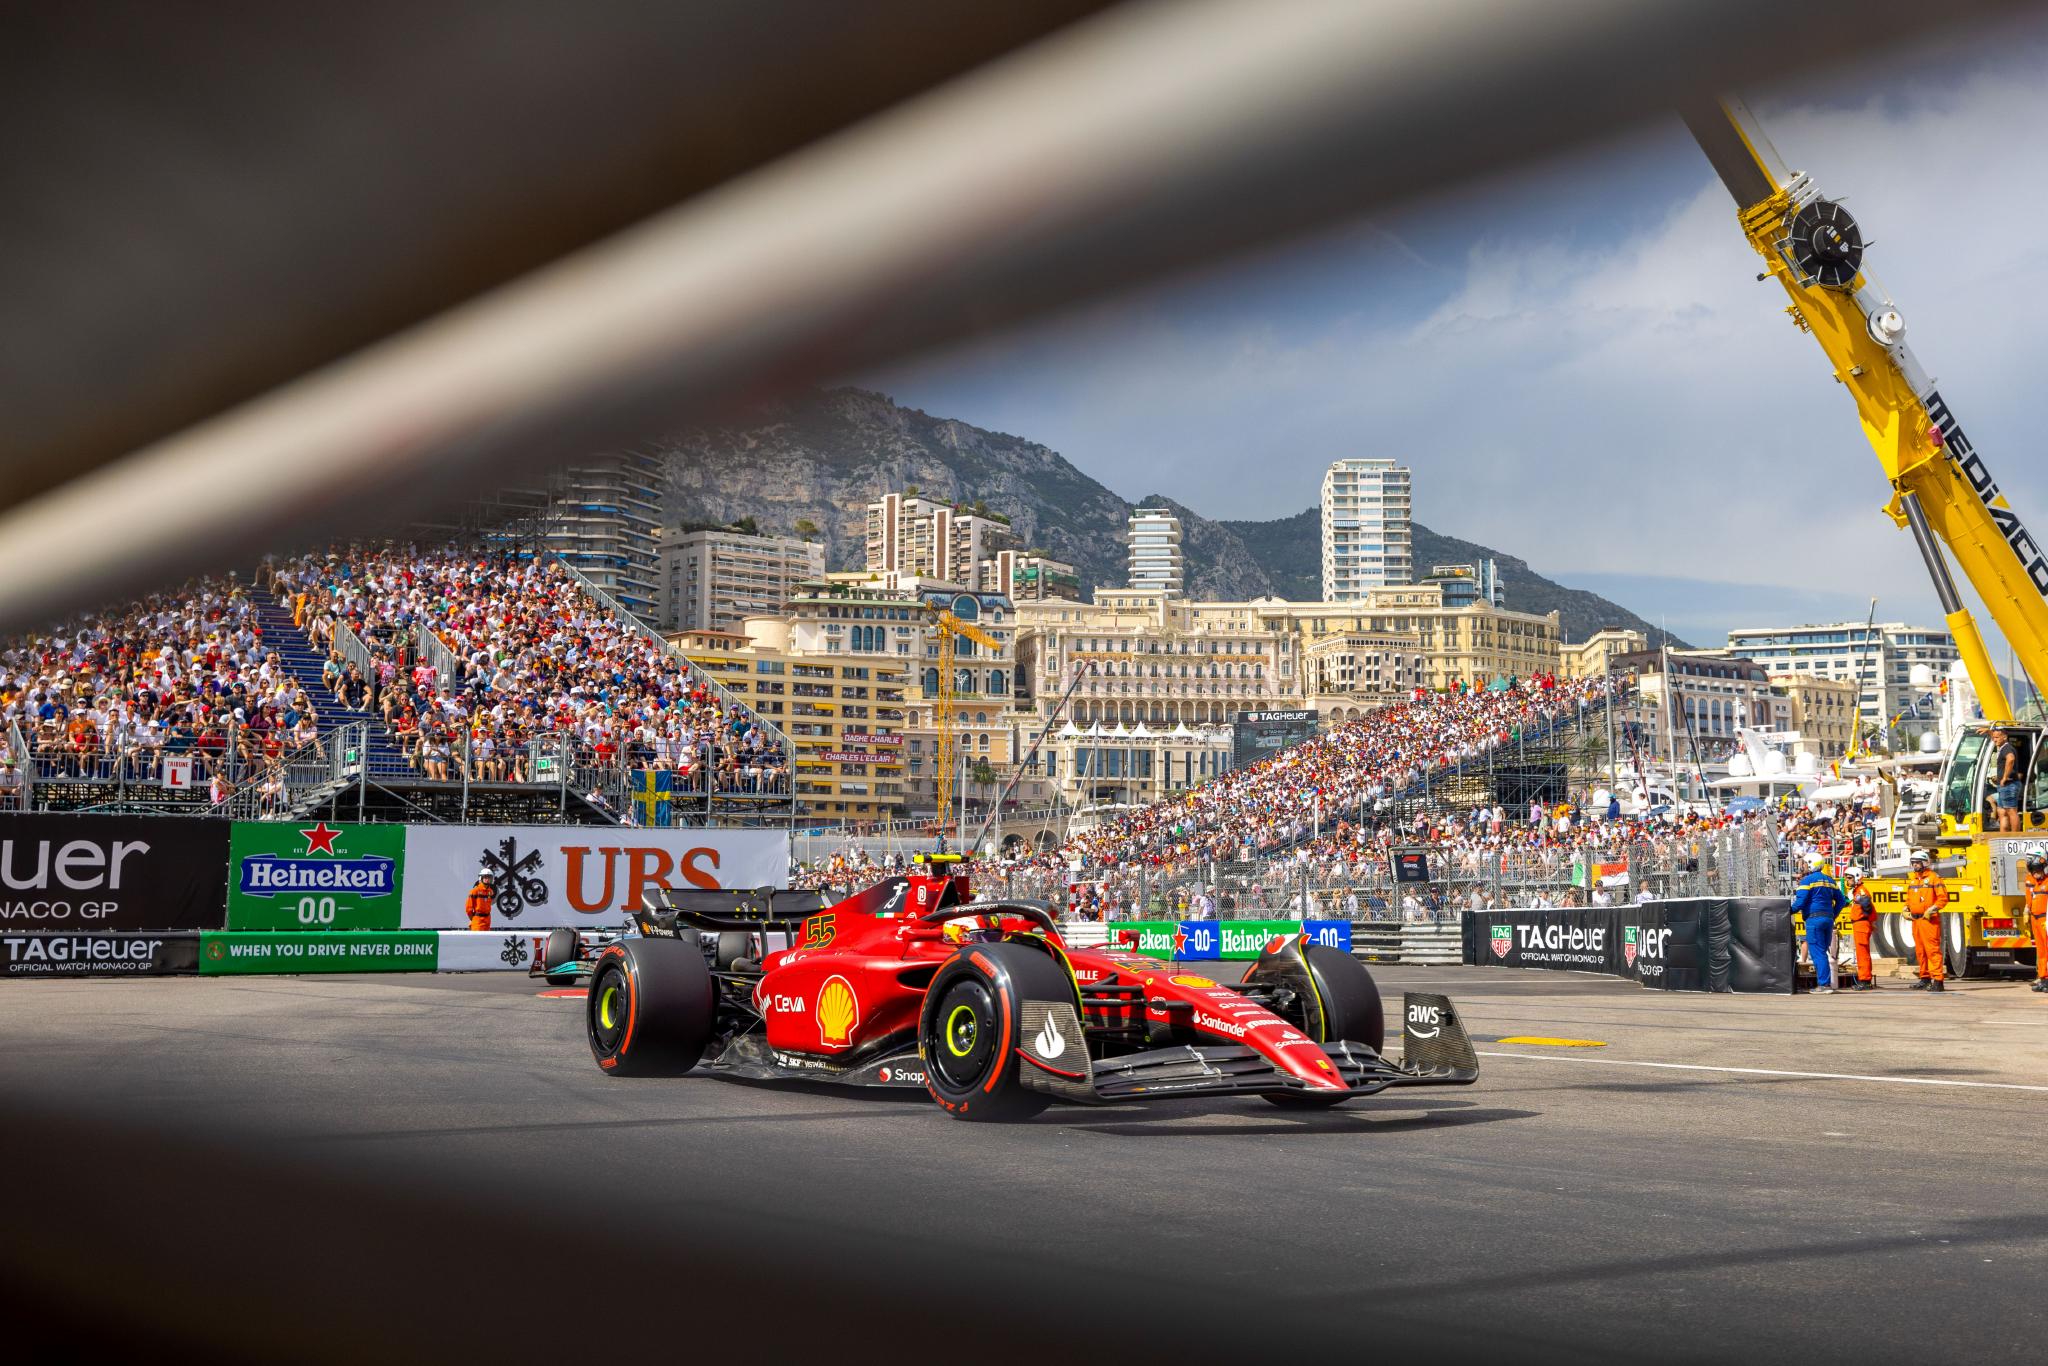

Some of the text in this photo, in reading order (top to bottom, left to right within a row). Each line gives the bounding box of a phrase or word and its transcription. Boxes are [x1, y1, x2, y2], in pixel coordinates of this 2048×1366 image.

[844, 734, 900, 744] DAGHE CHARLIE
[825, 753, 891, 763] CHARLES L'ECLAIR
[171, 769, 182, 785] L
[2007, 842, 2018, 854] 60
[249, 863, 386, 888] Heineken
[560, 846, 722, 915] UBS
[80, 901, 118, 919] GP
[801, 913, 837, 950] 55
[1493, 928, 1510, 938] TAG
[230, 943, 433, 957] WHEN YOU DRIVE NEVER DRINK
[1491, 940, 1512, 956] HEUER
[1521, 952, 1550, 961] OFFICIAL
[1551, 953, 1571, 962] WATCH
[10, 962, 152, 972] OFFICIAL WATCH MONACO GP
[1652, 965, 1664, 976] GP
[1073, 969, 1099, 981] MILLE
[1408, 1004, 1439, 1024] aws
[1201, 1013, 1248, 1038] Santander
[894, 1068, 926, 1084] Snap
